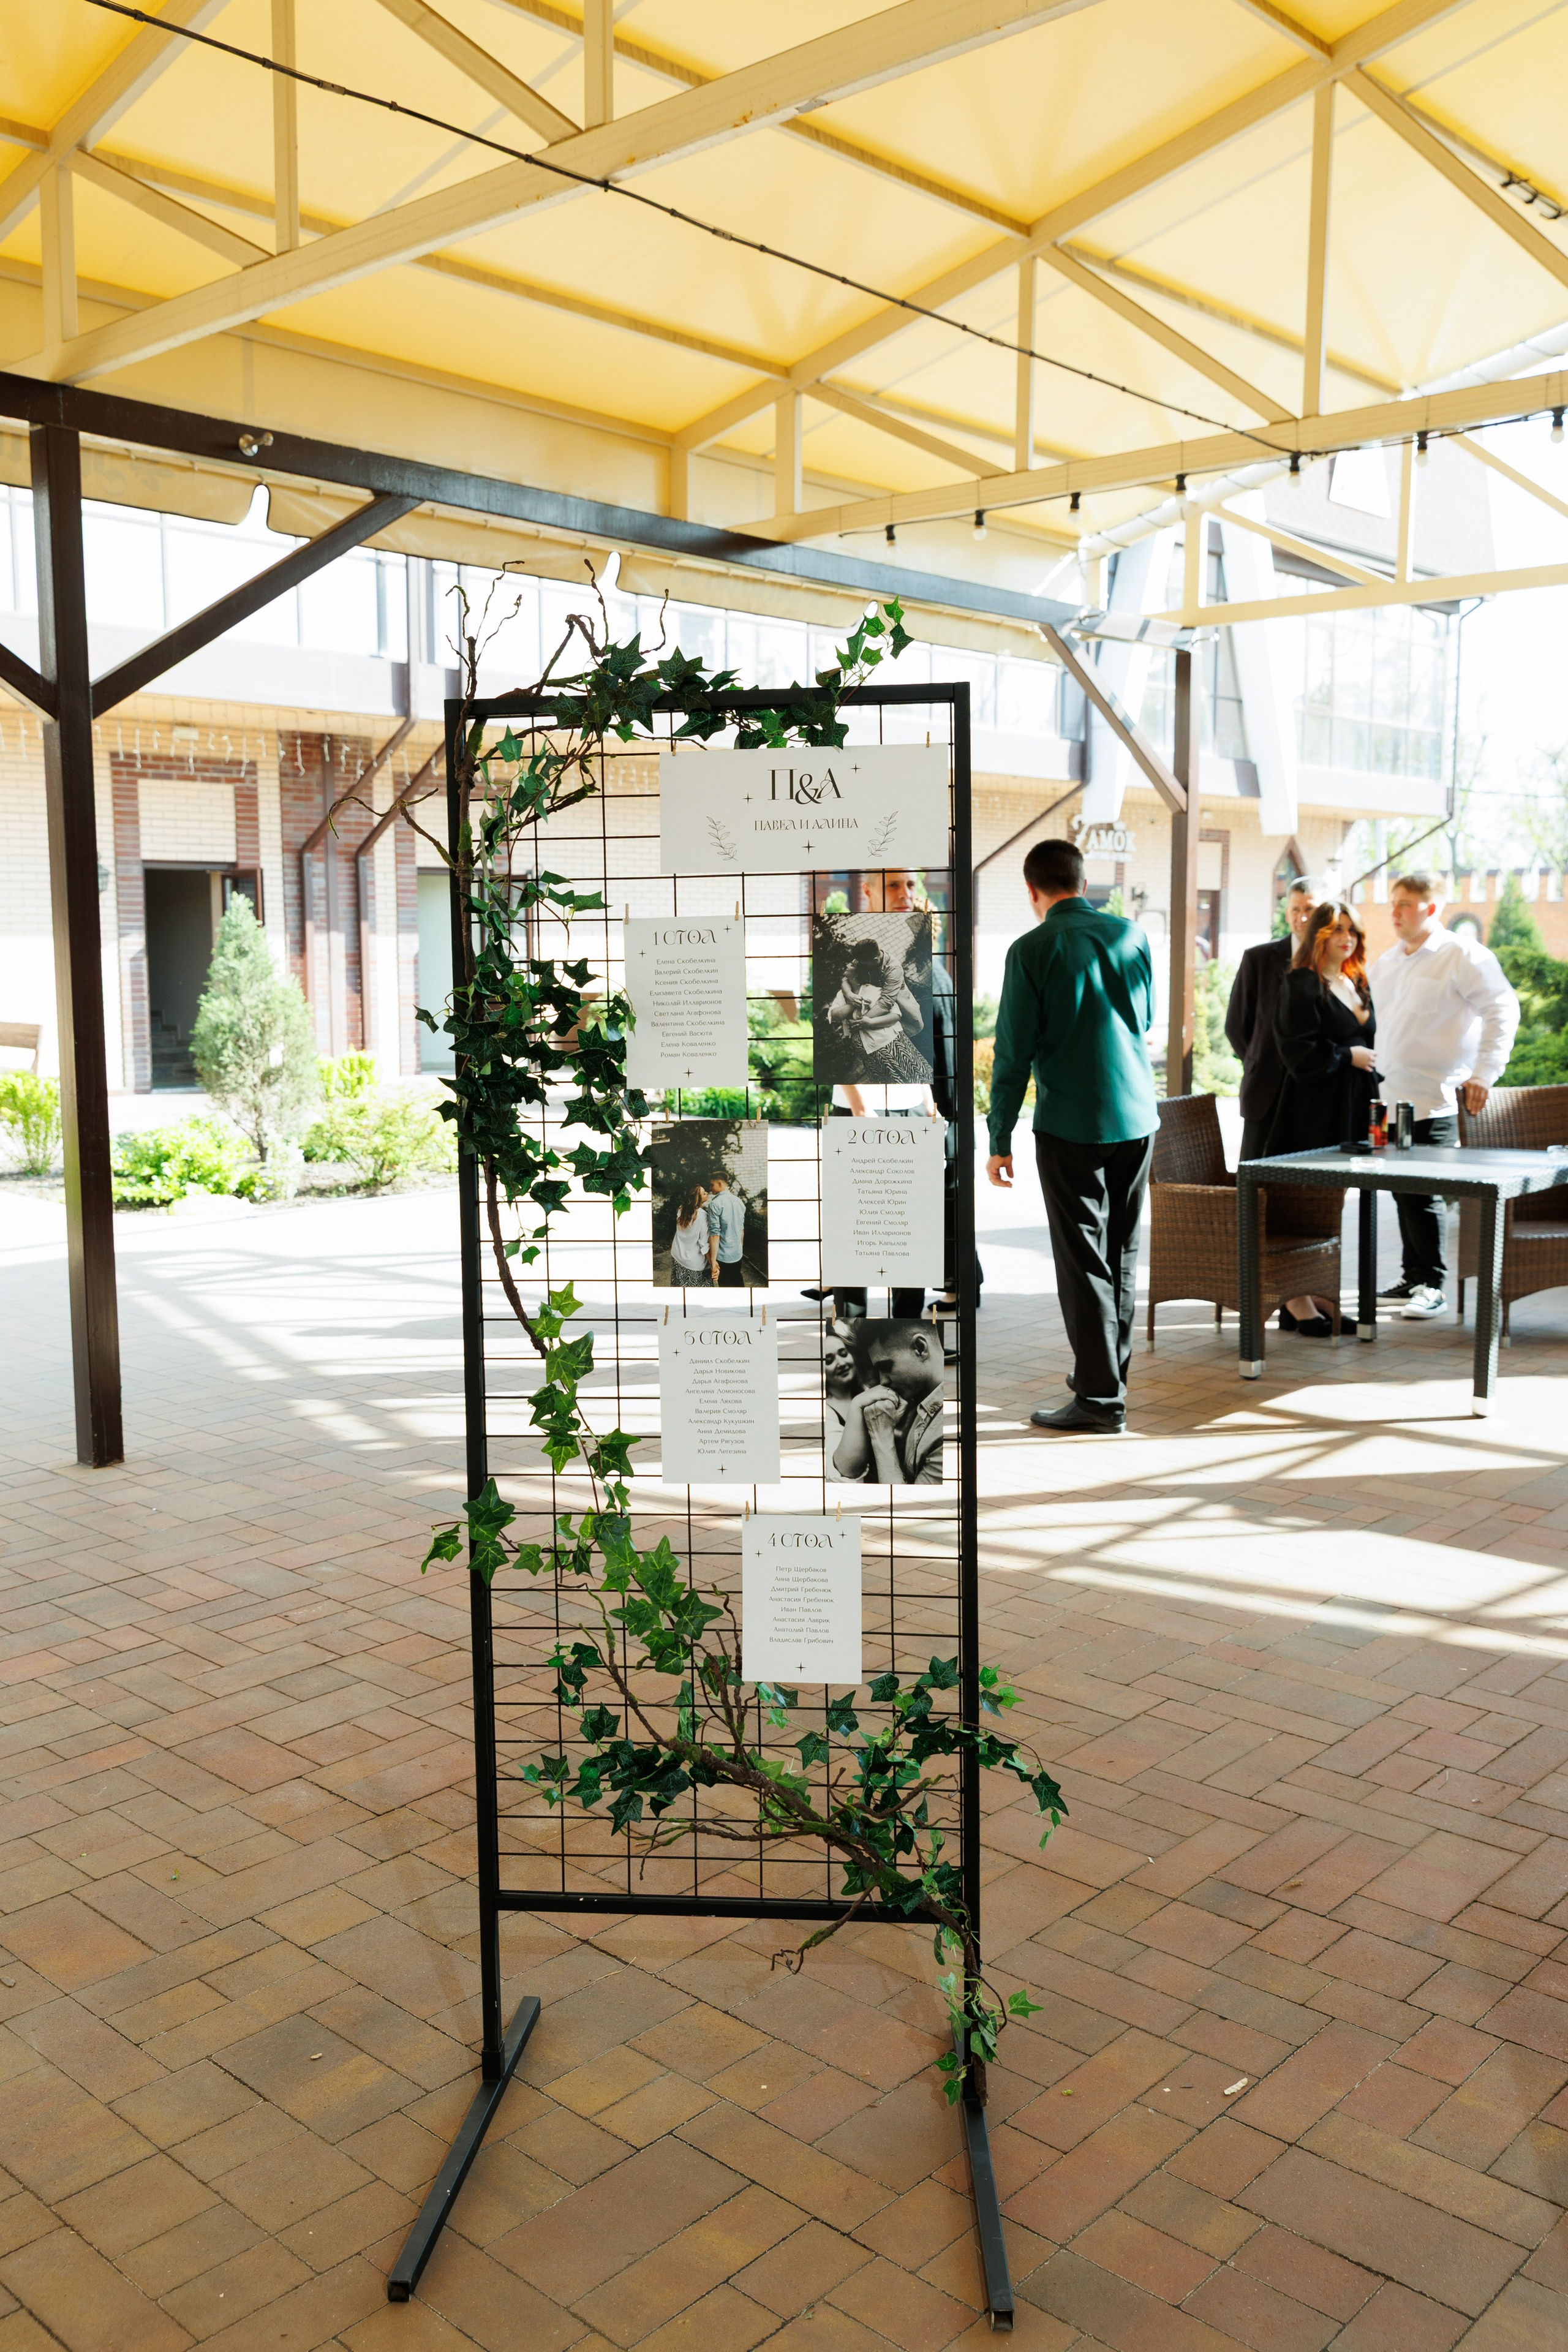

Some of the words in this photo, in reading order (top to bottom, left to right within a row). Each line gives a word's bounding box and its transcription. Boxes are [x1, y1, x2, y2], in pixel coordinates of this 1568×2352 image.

[767, 767, 844, 805] П&А
[754, 819, 797, 831] ПАВЕЛ
[799, 819, 810, 830] И
[812, 818, 859, 829] АЛИНА
[653, 931, 659, 945] 1
[663, 929, 717, 945] СТОЛ
[847, 1129, 857, 1144] 2
[862, 1129, 918, 1145] СТОЛ
[684, 1330, 695, 1346] 3
[699, 1330, 753, 1346] СТОЛ
[767, 1533, 777, 1547] 4
[781, 1533, 834, 1548] СТОЛ
